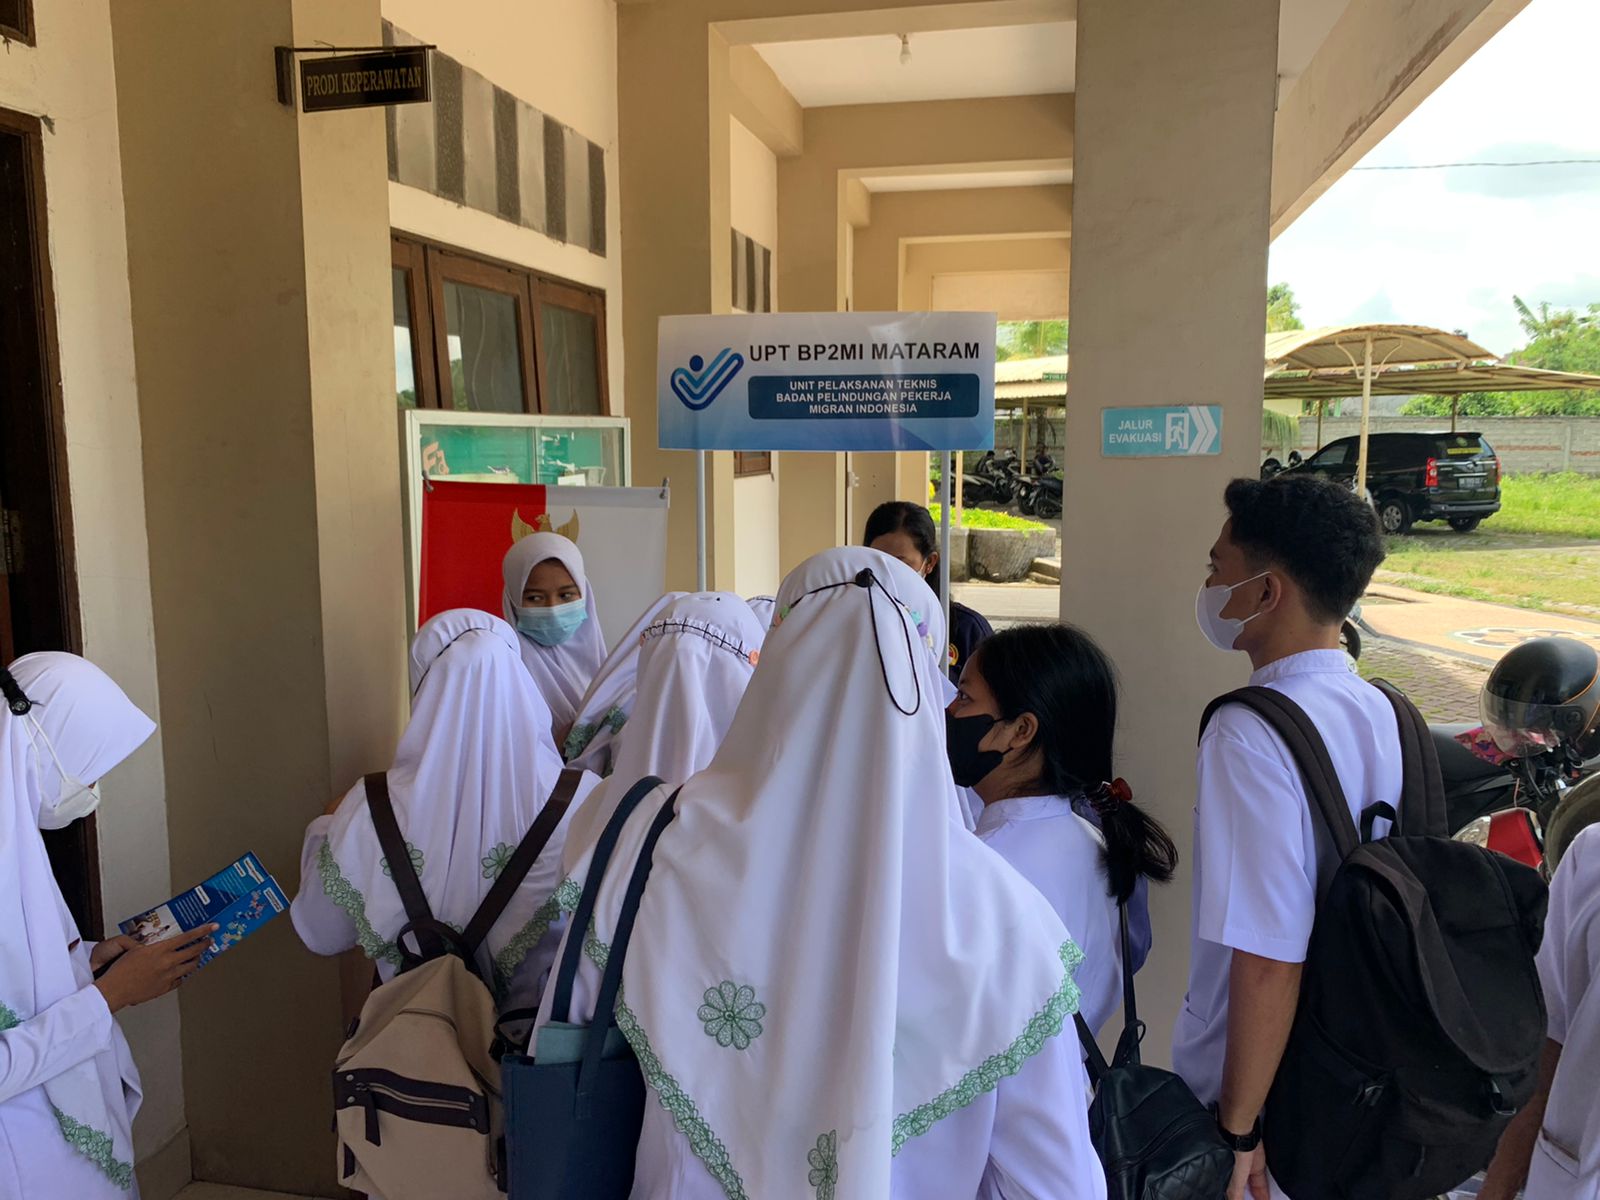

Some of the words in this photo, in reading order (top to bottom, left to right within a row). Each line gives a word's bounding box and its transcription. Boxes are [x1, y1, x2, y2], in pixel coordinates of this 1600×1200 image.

[306, 73, 339, 96] PRODI
[341, 67, 421, 93] KEPERAWATAN
[749, 344, 790, 362] UPT
[798, 343, 863, 361] BP2MI
[872, 342, 979, 360] MATARAM
[789, 381, 816, 391] UNIT
[817, 380, 895, 390] PELAKSANAN
[896, 379, 937, 389] TEKNIS
[775, 393, 815, 403] BADAN
[817, 392, 898, 402] PELINDUNGAN
[900, 391, 952, 401] PEKERJA
[809, 404, 853, 415] MIGRAN
[855, 403, 918, 413] INDONESIA
[1118, 419, 1153, 430] JALUR
[1108, 432, 1162, 444] EVAKUASI
